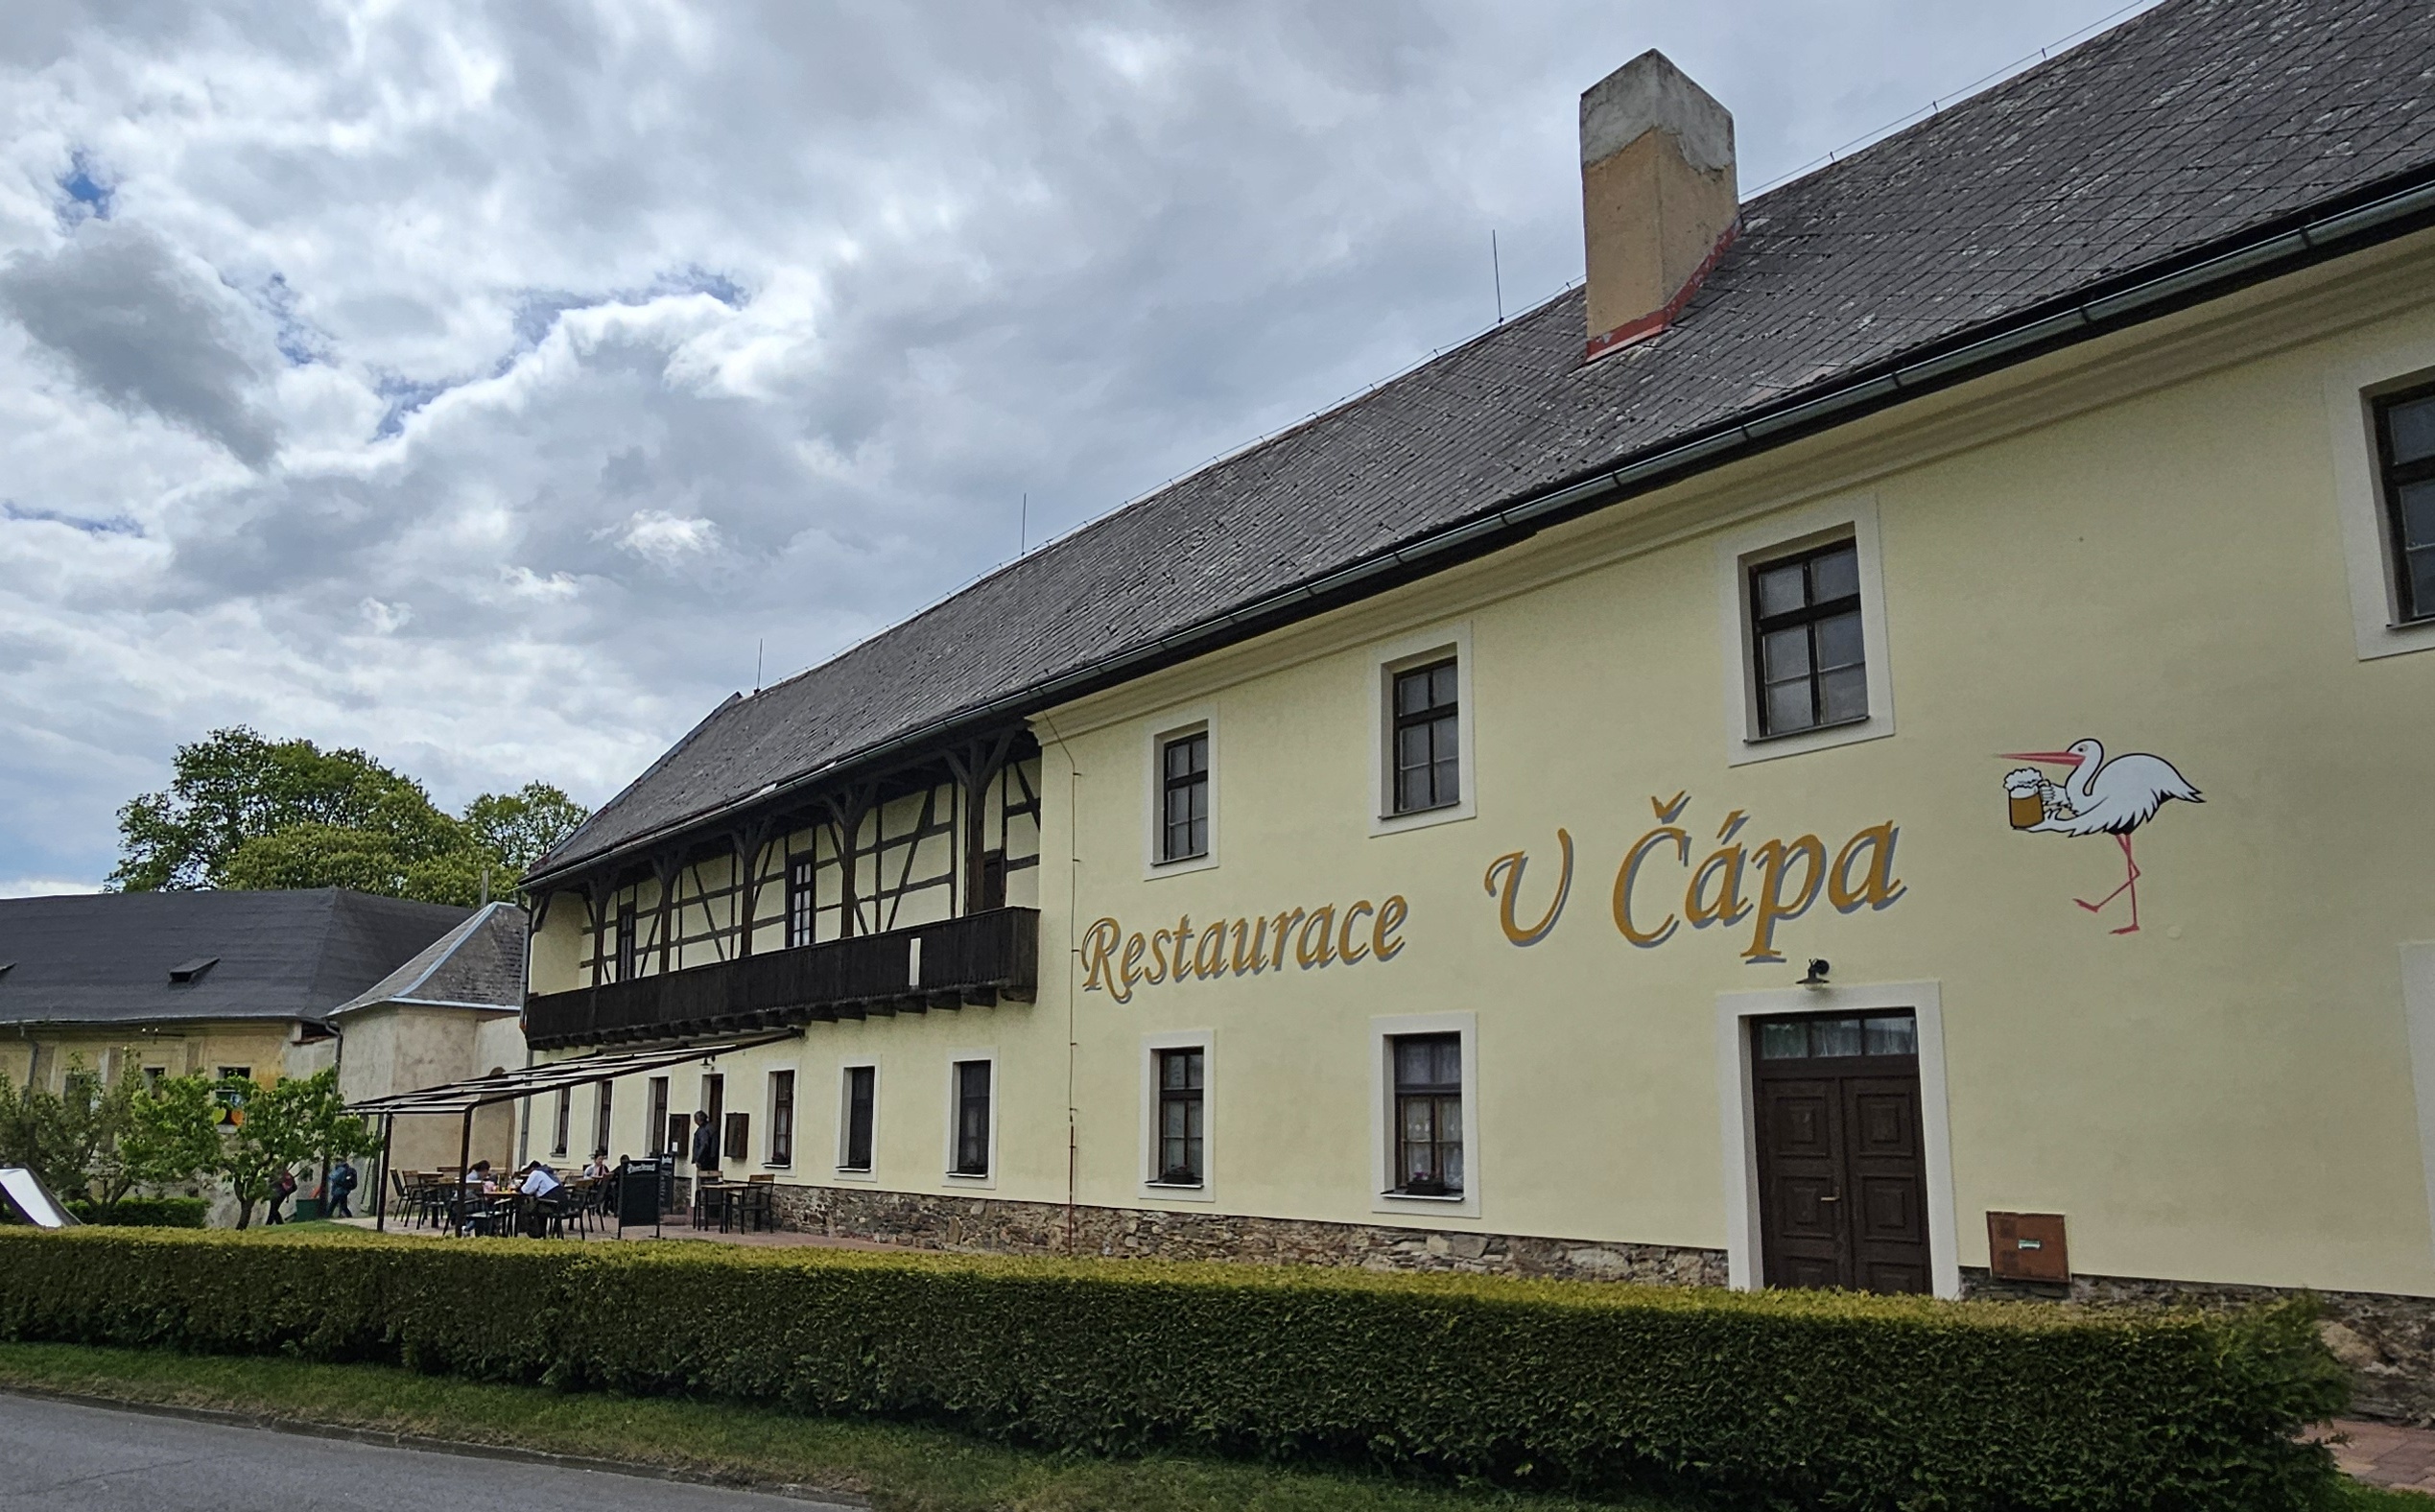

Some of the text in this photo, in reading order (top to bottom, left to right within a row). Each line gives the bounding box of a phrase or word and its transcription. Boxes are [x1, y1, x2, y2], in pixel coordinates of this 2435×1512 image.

[1081, 791, 1907, 1004] Restaurace U Čápa
